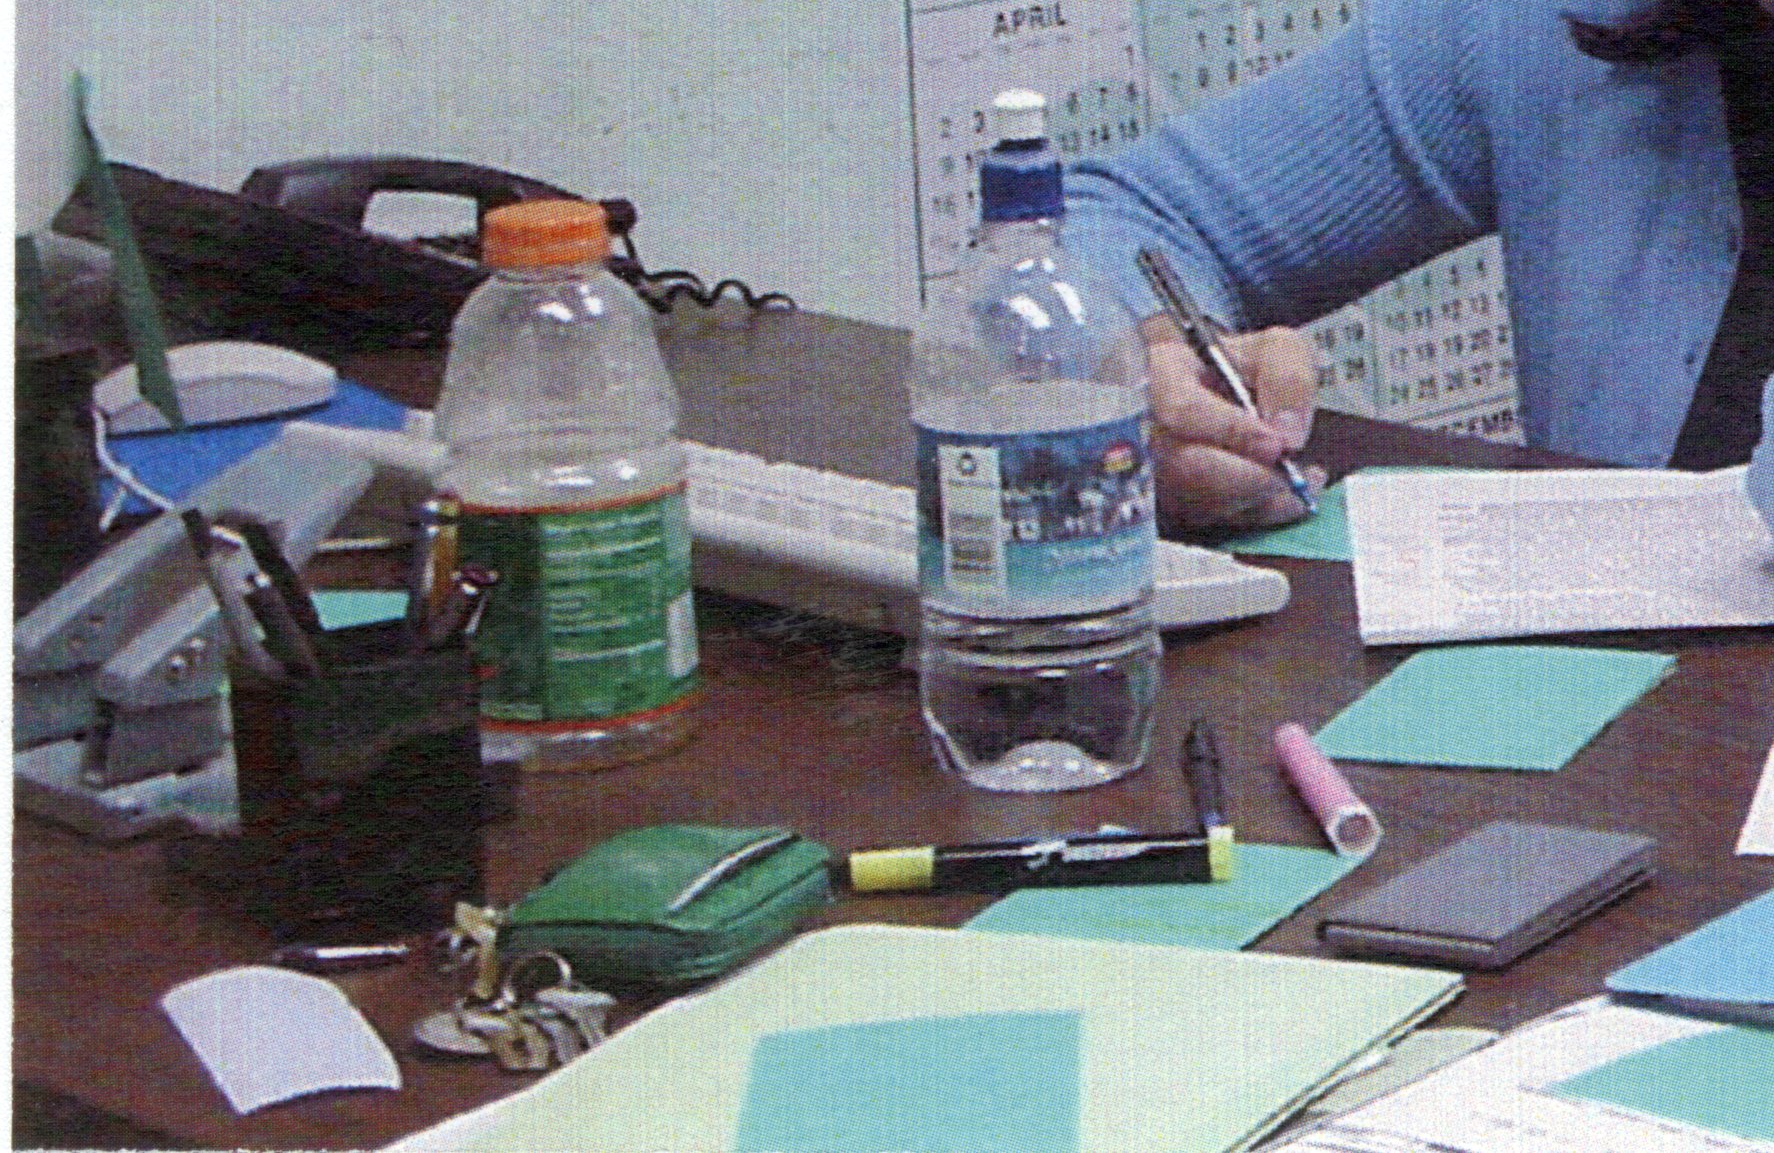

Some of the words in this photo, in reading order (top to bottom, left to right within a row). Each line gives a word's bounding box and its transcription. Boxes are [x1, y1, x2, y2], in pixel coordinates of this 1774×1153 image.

[993, 3, 1067, 36] APRIL
[1226, 24, 1235, 46] 2
[1256, 20, 1265, 42] 3
[941, 117, 951, 138] 2
[974, 110, 985, 133] 3
